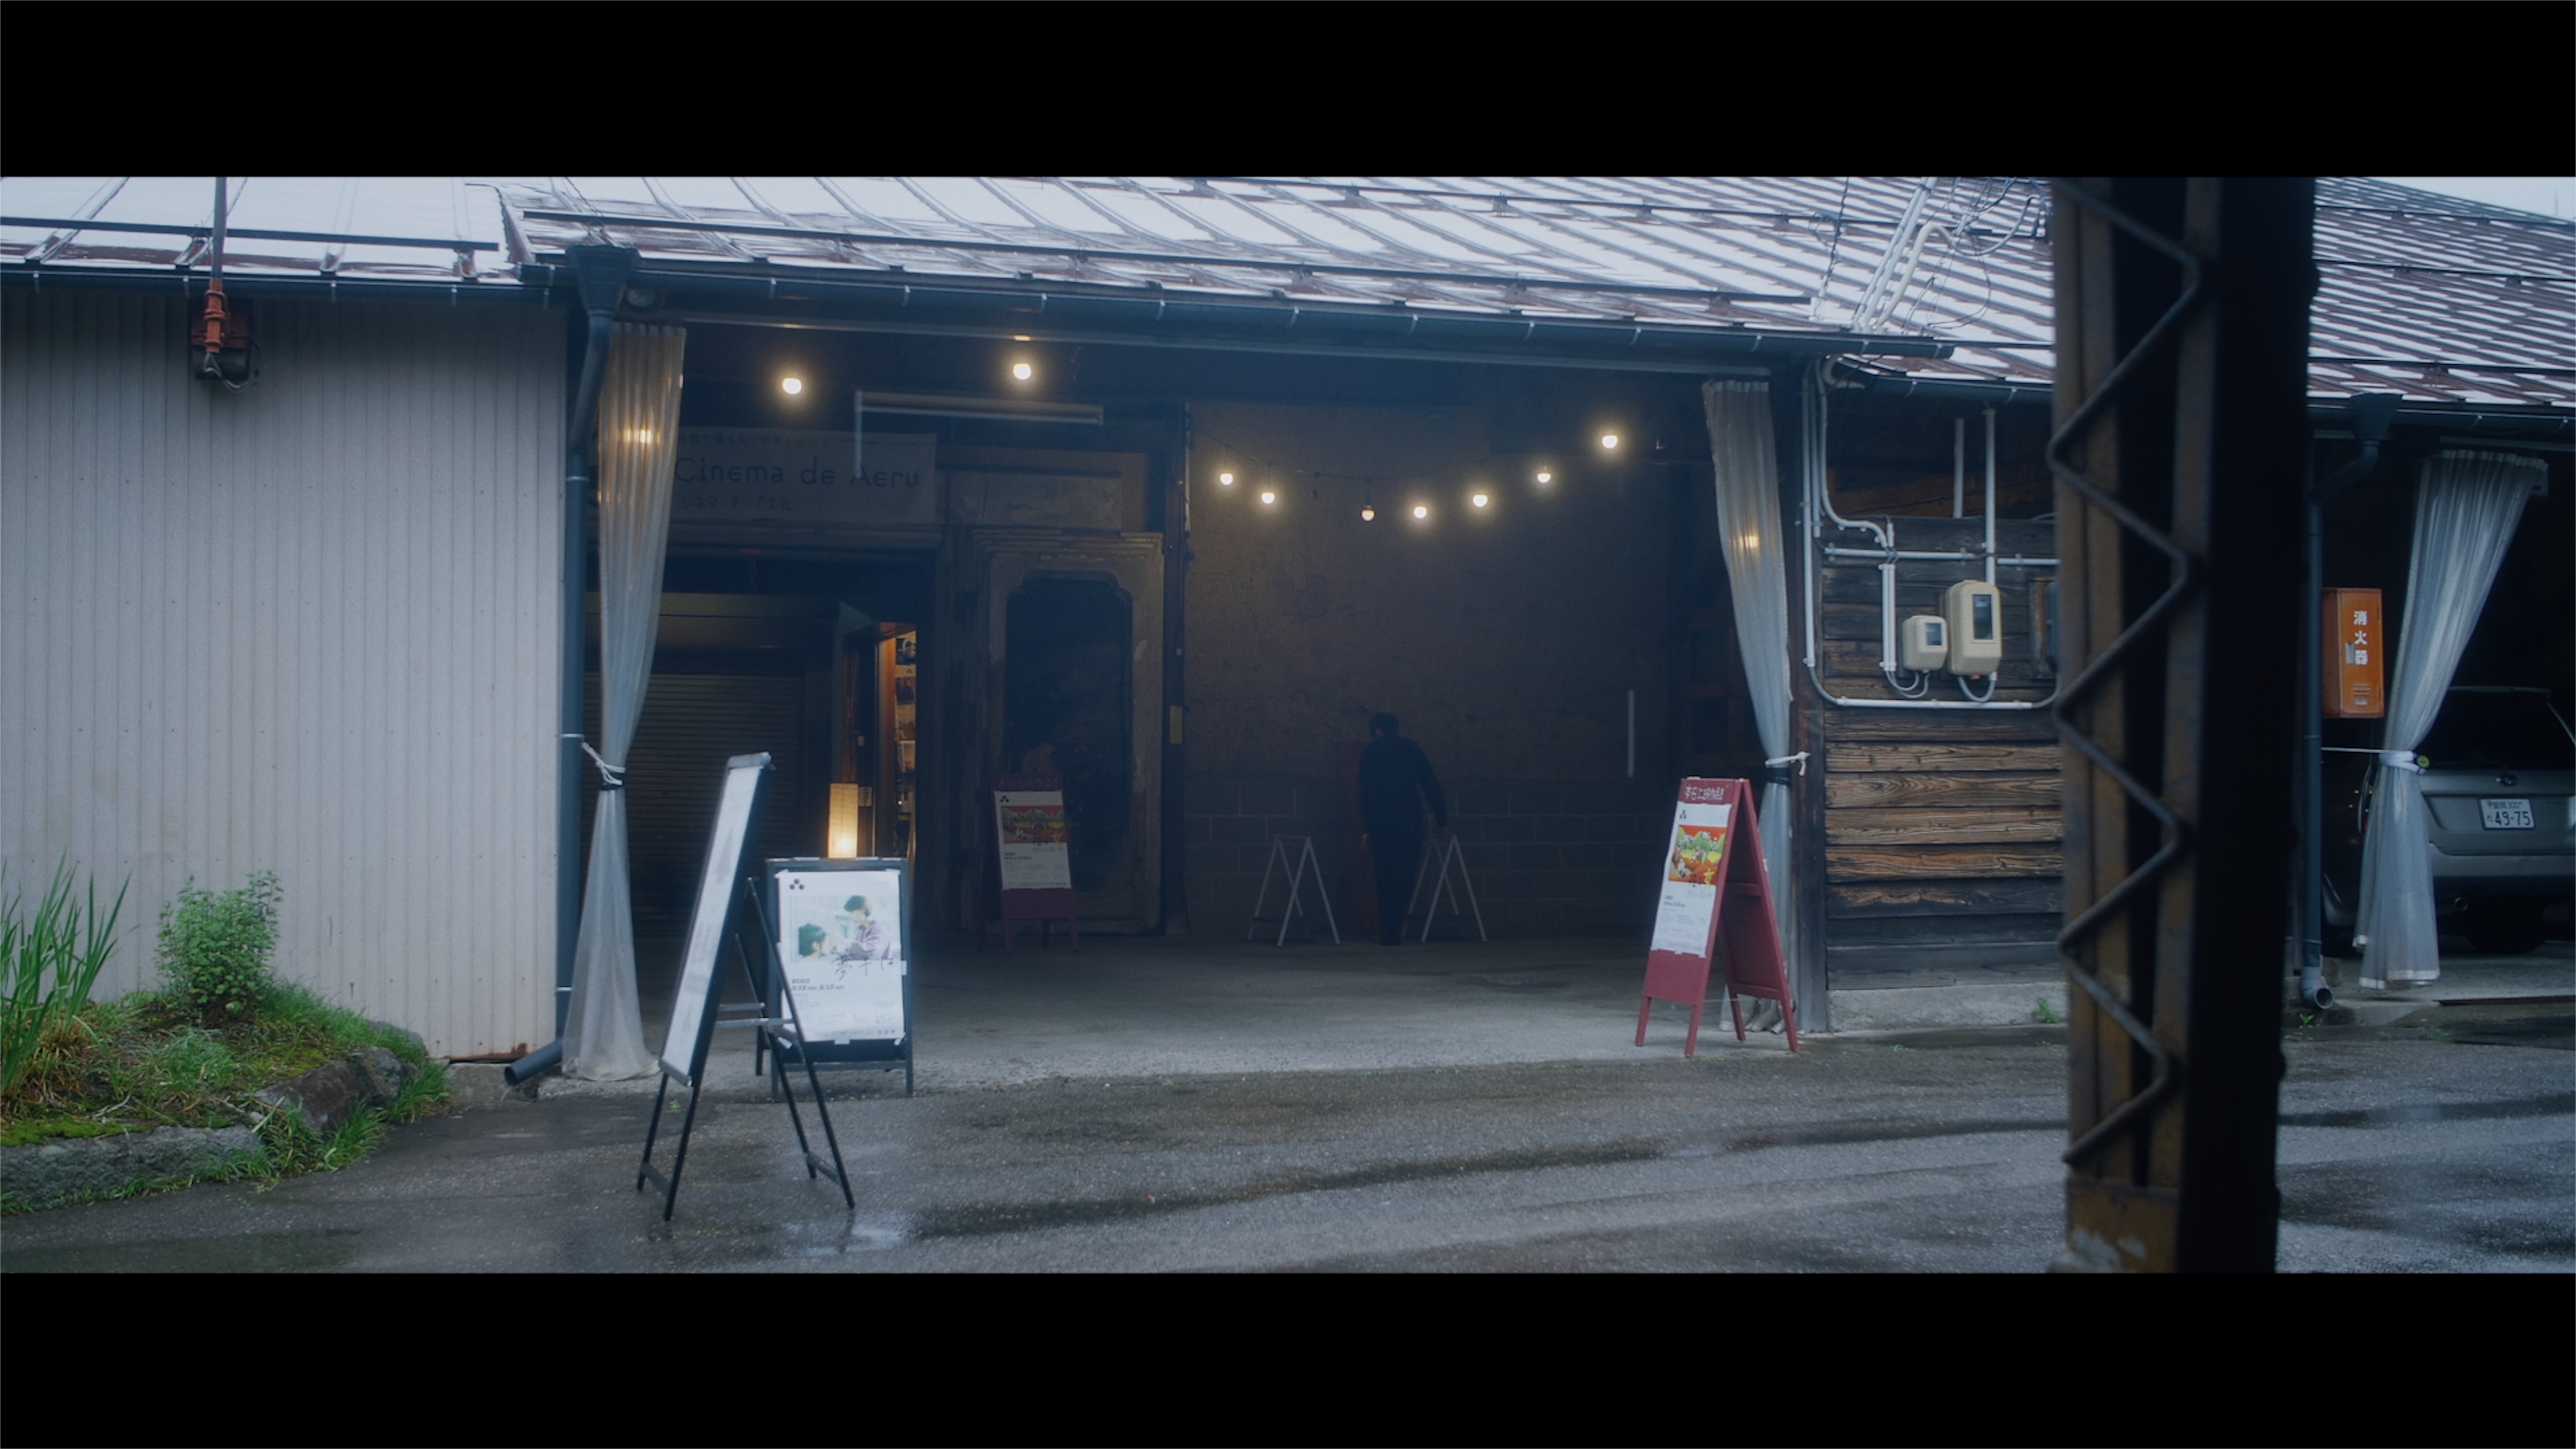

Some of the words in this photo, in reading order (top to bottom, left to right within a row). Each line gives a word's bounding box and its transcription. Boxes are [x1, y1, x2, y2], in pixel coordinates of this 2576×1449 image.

[675, 457, 784, 483] Cinema
[800, 456, 836, 485] de
[849, 464, 919, 488] Aeru
[681, 495, 794, 512] シネマ・デ・アエル
[2353, 610, 2369, 665] 消火器
[2495, 810, 2531, 826] 49-75
